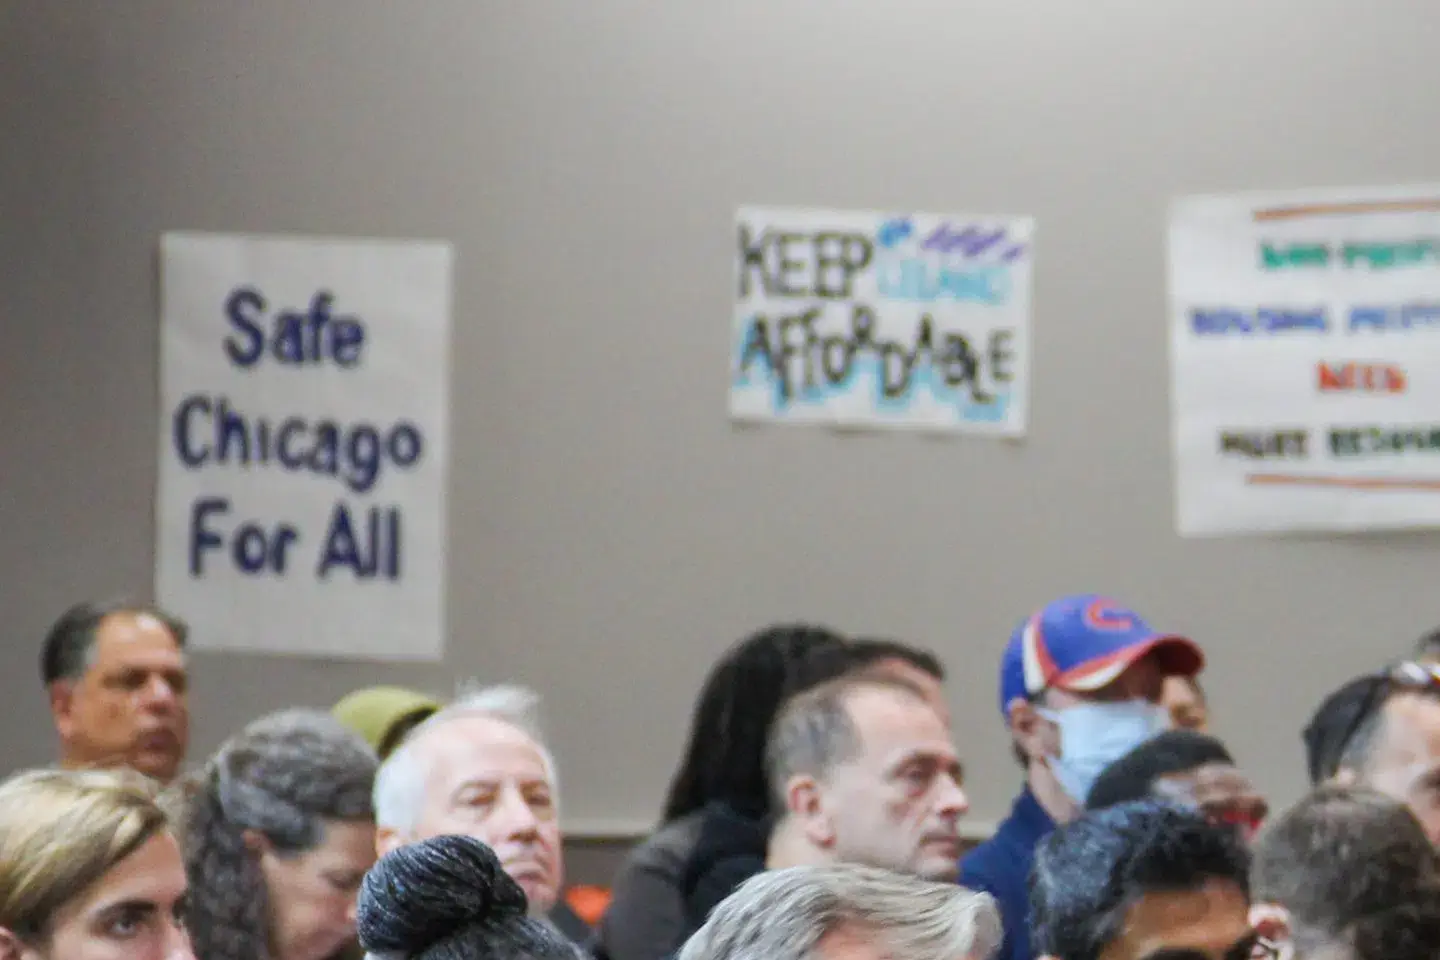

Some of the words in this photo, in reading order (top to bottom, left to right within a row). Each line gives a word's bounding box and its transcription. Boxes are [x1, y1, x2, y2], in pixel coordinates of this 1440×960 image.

[737, 222, 874, 298] KEEP
[223, 286, 365, 367] Safe
[738, 306, 1016, 406] AFFORDABLE
[172, 392, 425, 492] Chicago
[188, 496, 299, 577] For
[317, 499, 403, 580] All
